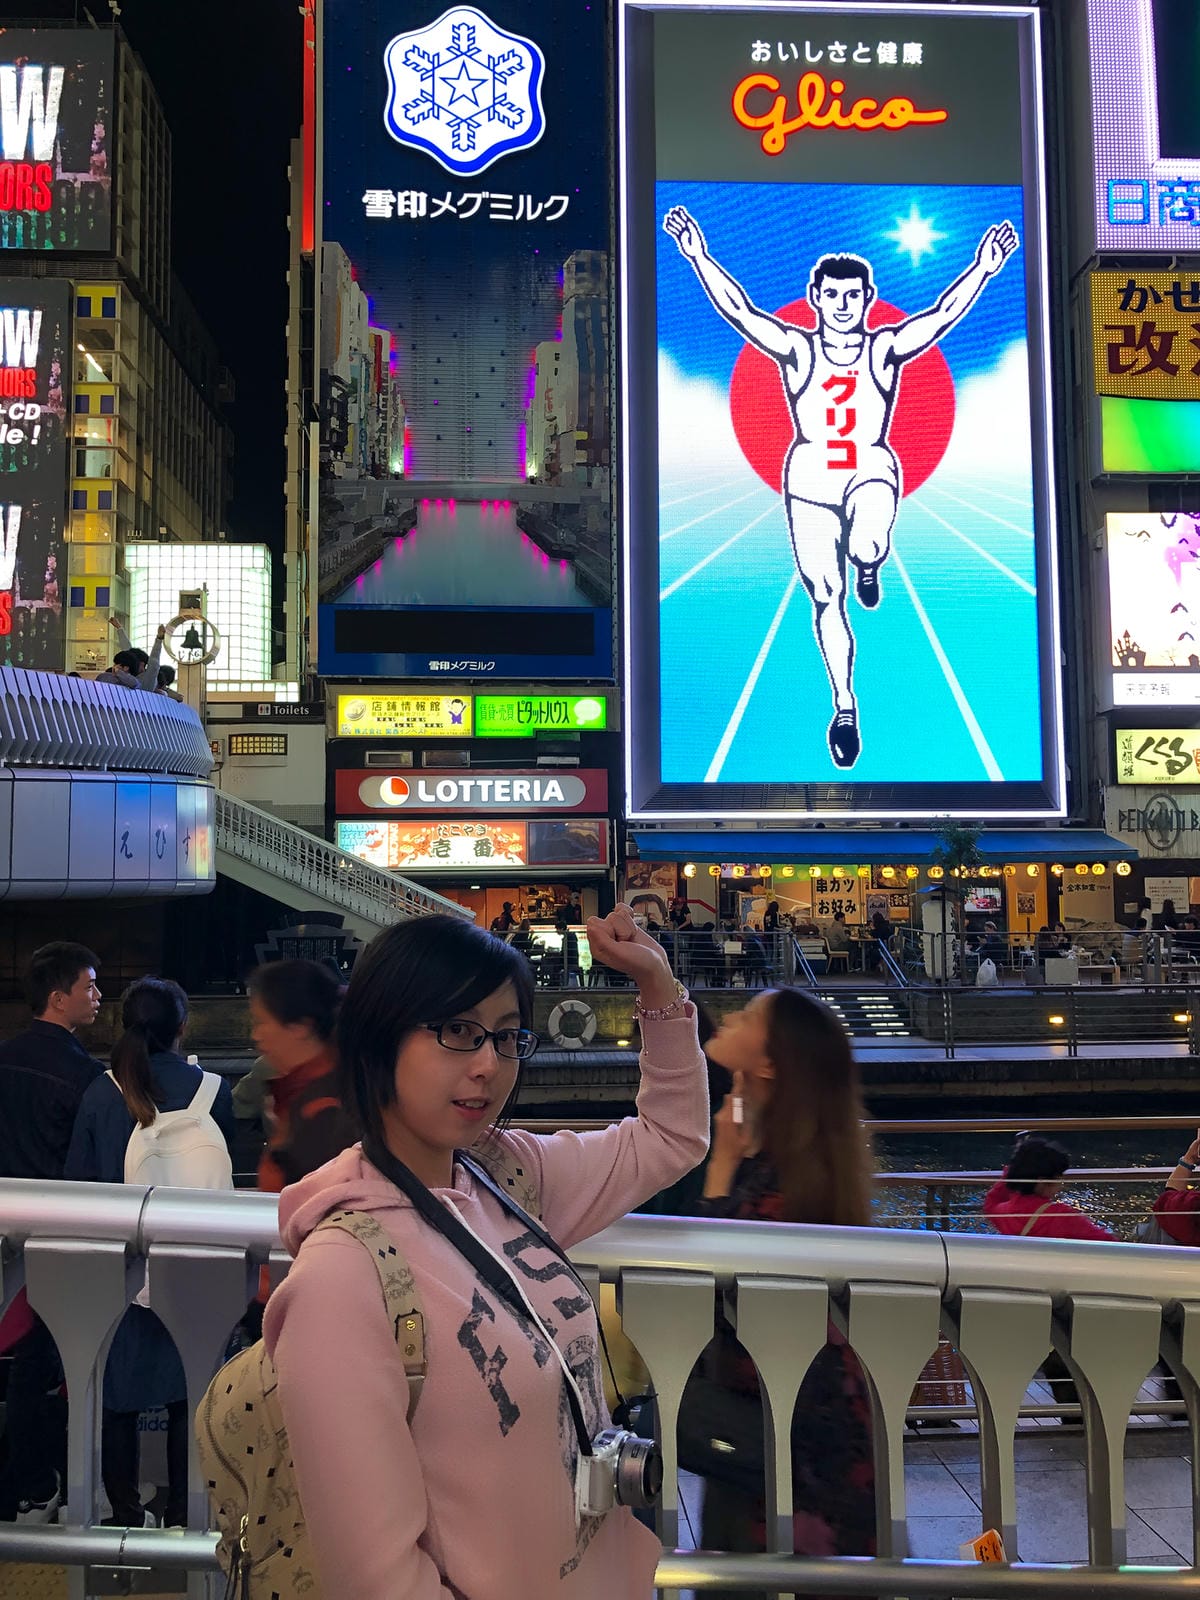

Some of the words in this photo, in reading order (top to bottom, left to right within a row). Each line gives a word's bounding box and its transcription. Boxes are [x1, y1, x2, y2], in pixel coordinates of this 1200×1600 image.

[751, 40, 923, 64] おいしさと健康
[732, 71, 948, 156] Glico
[361, 189, 570, 221] 雪印メグミルク
[0, 309, 42, 368] W
[821, 370, 859, 470] グリコ
[428, 660, 496, 671] 雪印メグミルク
[273, 705, 310, 715] Toilets
[372, 701, 440, 712] 店舗情報館
[517, 700, 570, 724] ピタットハウス
[1134, 736, 1193, 776] くくる
[418, 780, 565, 802] LOTTERIA
[816, 878, 855, 893] 串カツ
[818, 899, 857, 914] お好み
[136, 1414, 169, 1431] dida
